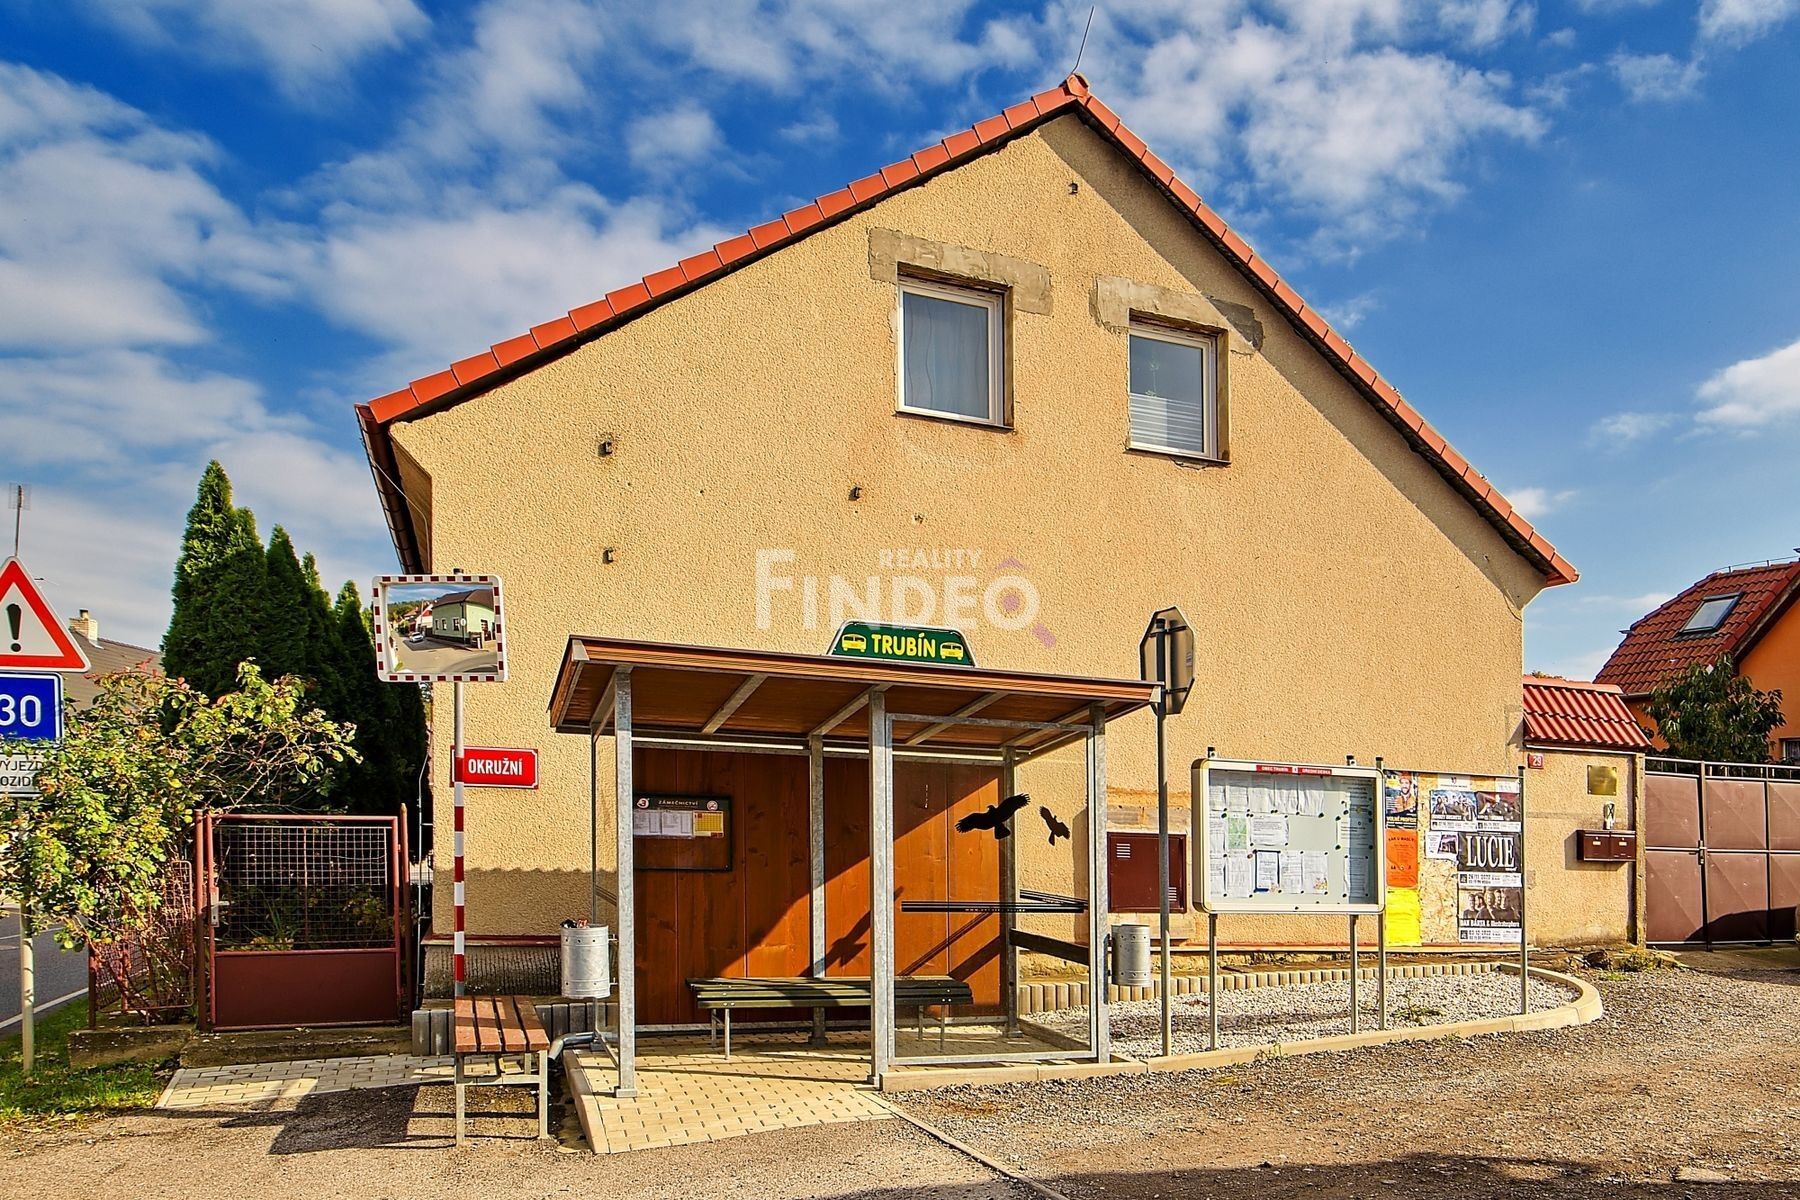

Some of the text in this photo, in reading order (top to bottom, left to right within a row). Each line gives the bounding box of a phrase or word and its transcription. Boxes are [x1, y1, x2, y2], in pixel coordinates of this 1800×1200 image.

[871, 633, 936, 658] TRUBÍN
[0, 693, 41, 727] 30
[468, 758, 523, 776] OKRUŽNÍ
[1465, 835, 1516, 868] LUCIE
